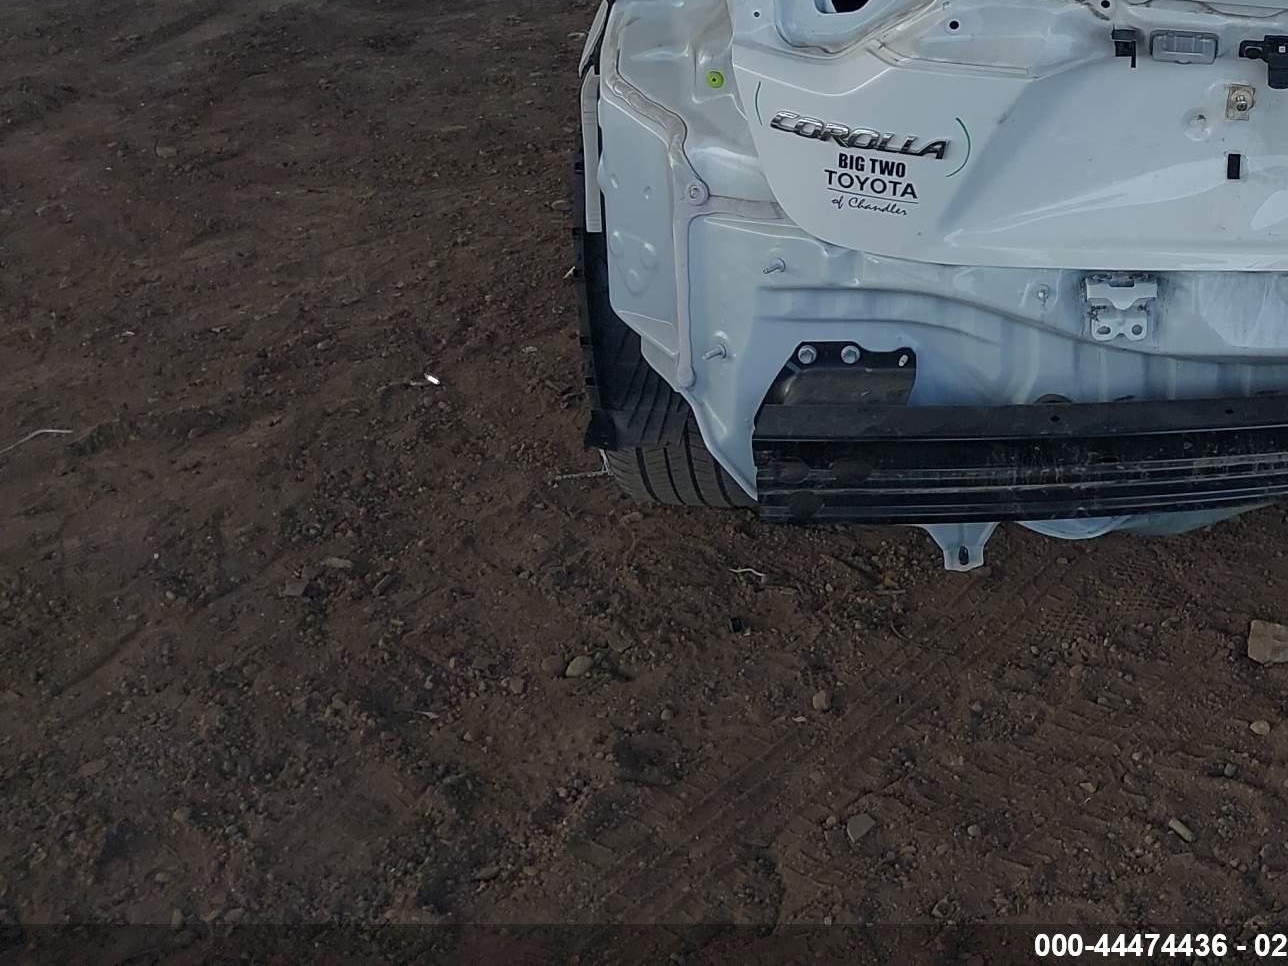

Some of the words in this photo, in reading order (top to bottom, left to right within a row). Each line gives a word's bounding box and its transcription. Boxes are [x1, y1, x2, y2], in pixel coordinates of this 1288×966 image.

[769, 110, 950, 160] COROLLA
[838, 152, 866, 172] BIG
[868, 158, 906, 178] TWO
[824, 169, 918, 199] TOYOTA
[831, 195, 844, 209] of
[847, 196, 908, 216] Chandler
